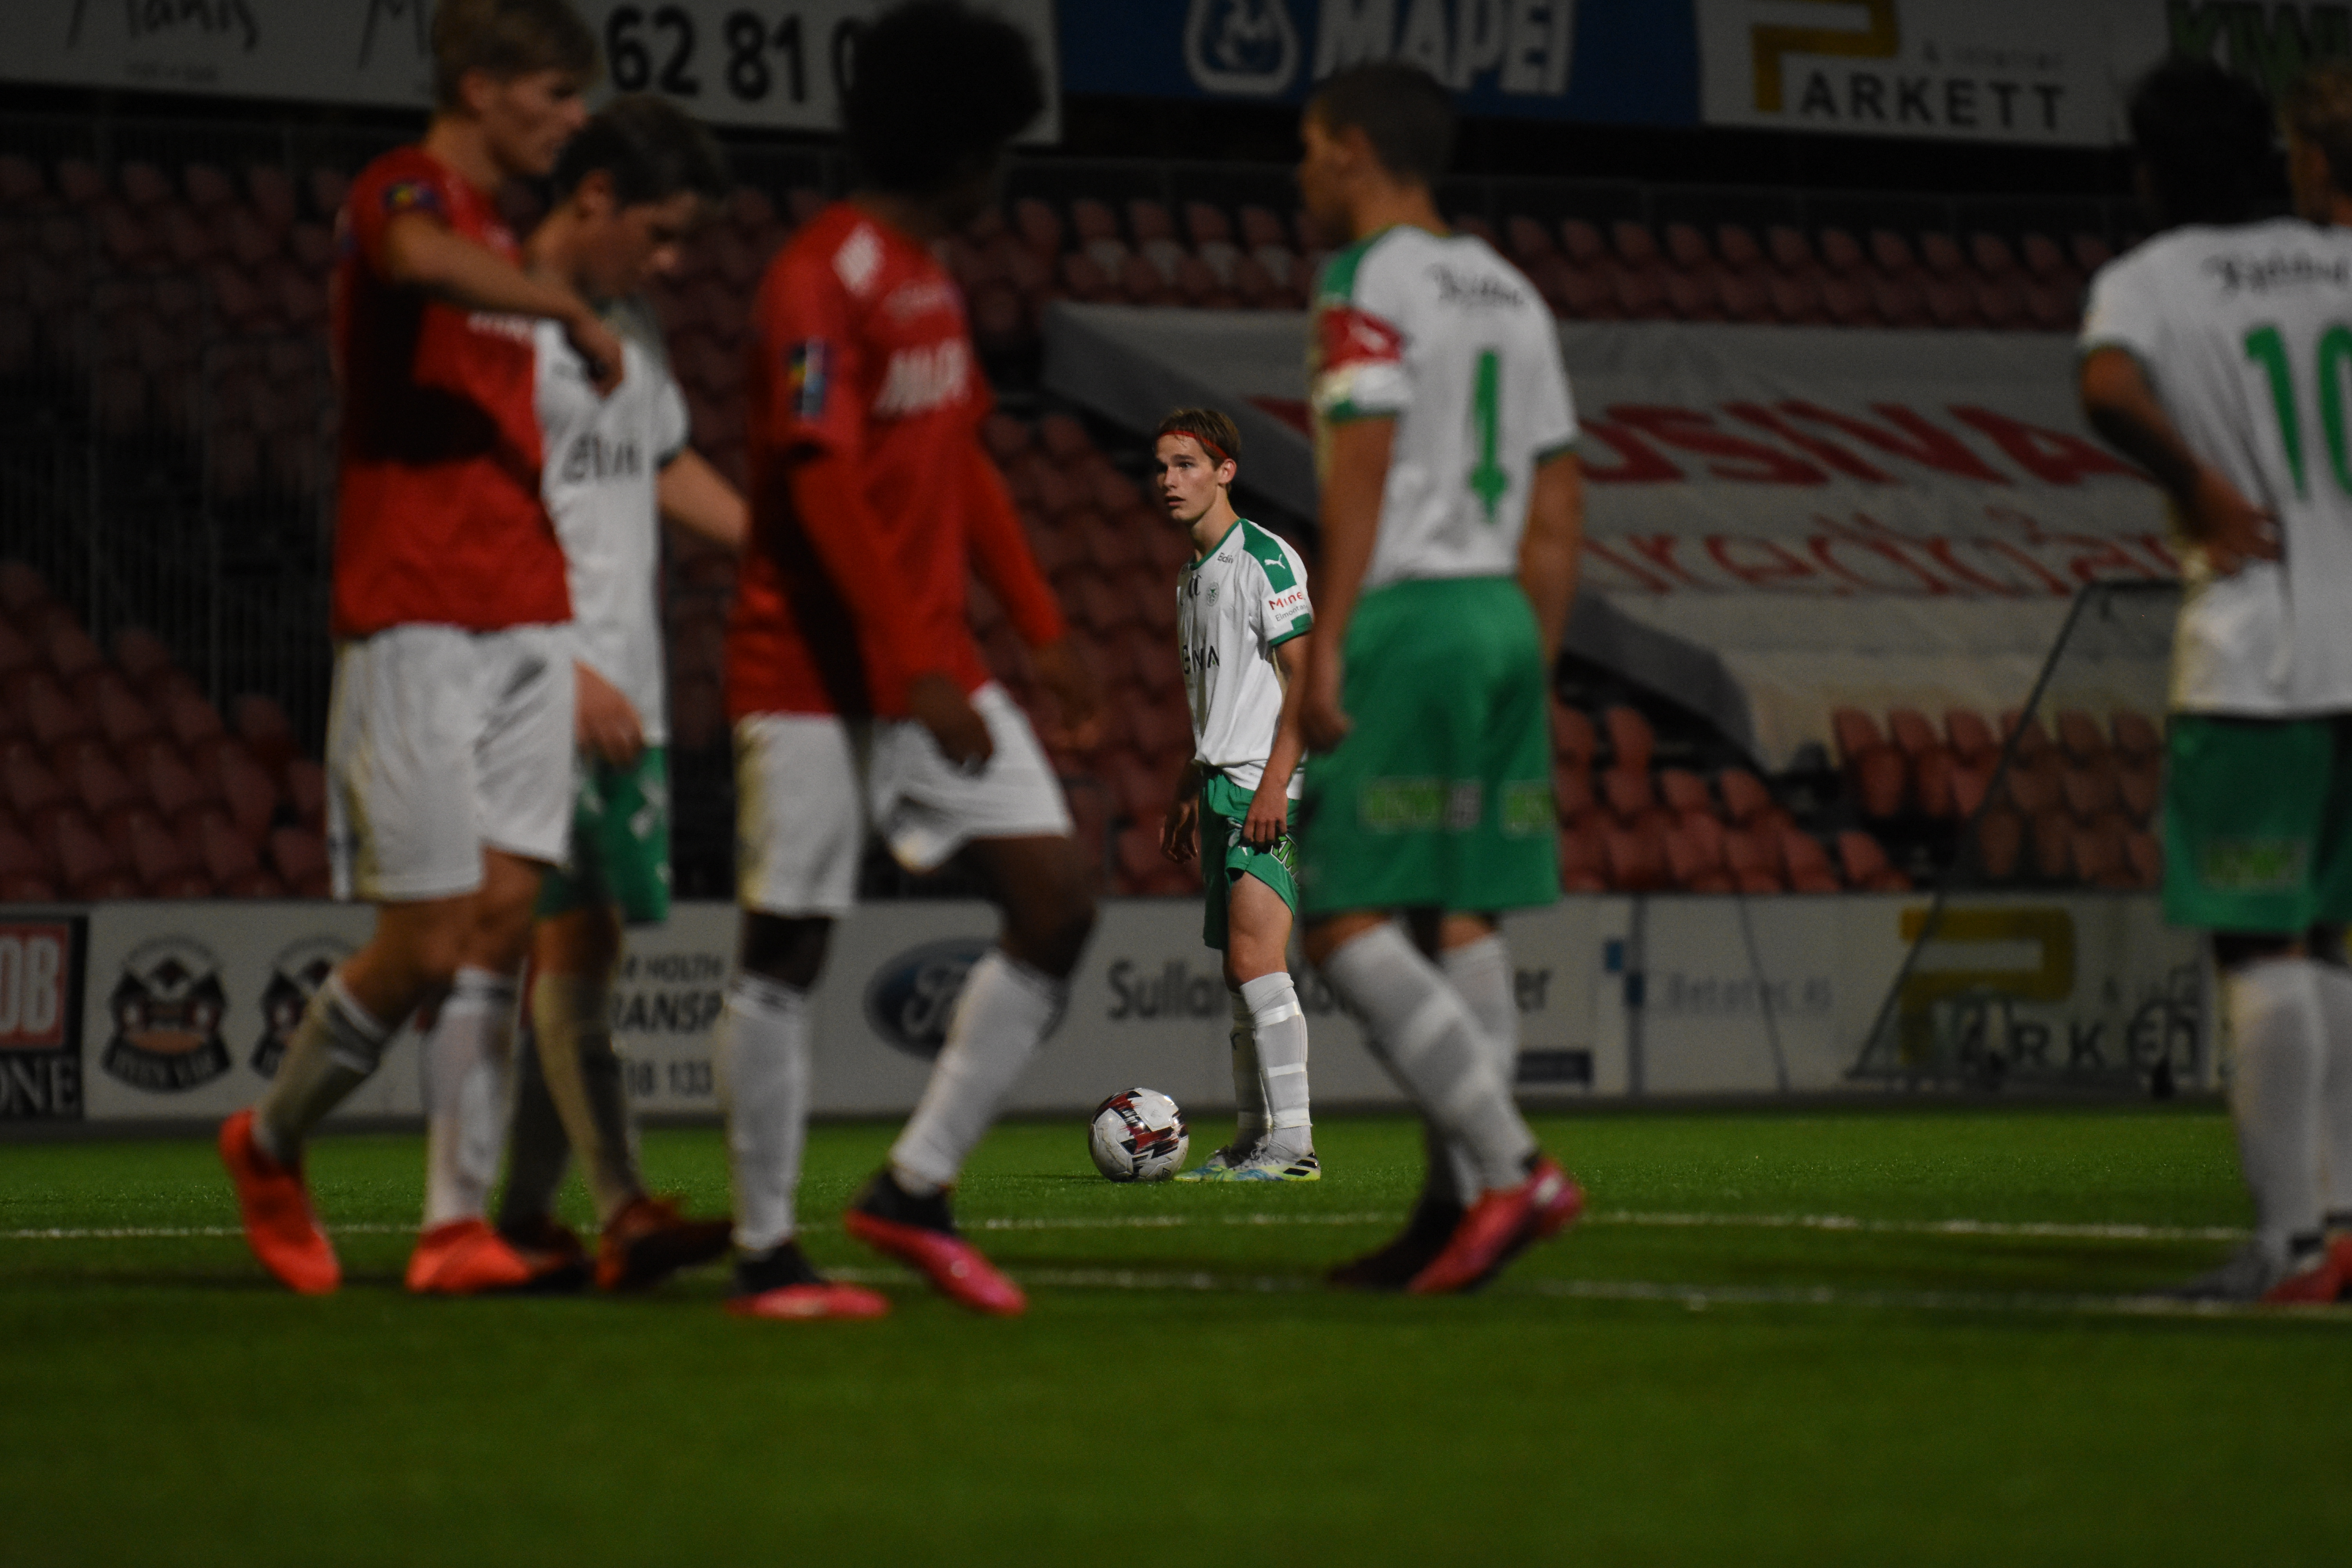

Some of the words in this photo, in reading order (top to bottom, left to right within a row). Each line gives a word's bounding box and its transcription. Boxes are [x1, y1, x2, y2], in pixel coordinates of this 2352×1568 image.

[605, 5, 699, 94] 62
[724, 10, 806, 103] 81
[1312, 0, 1577, 97] MAPEI
[2245, 326, 2352, 503] 10
[1269, 591, 1305, 611] Mine
[1275, 603, 1308, 622] Elmontas
[0, 935, 60, 1036] OB
[610, 989, 724, 1036] RANSP
[1107, 955, 1228, 1020] Sulla
